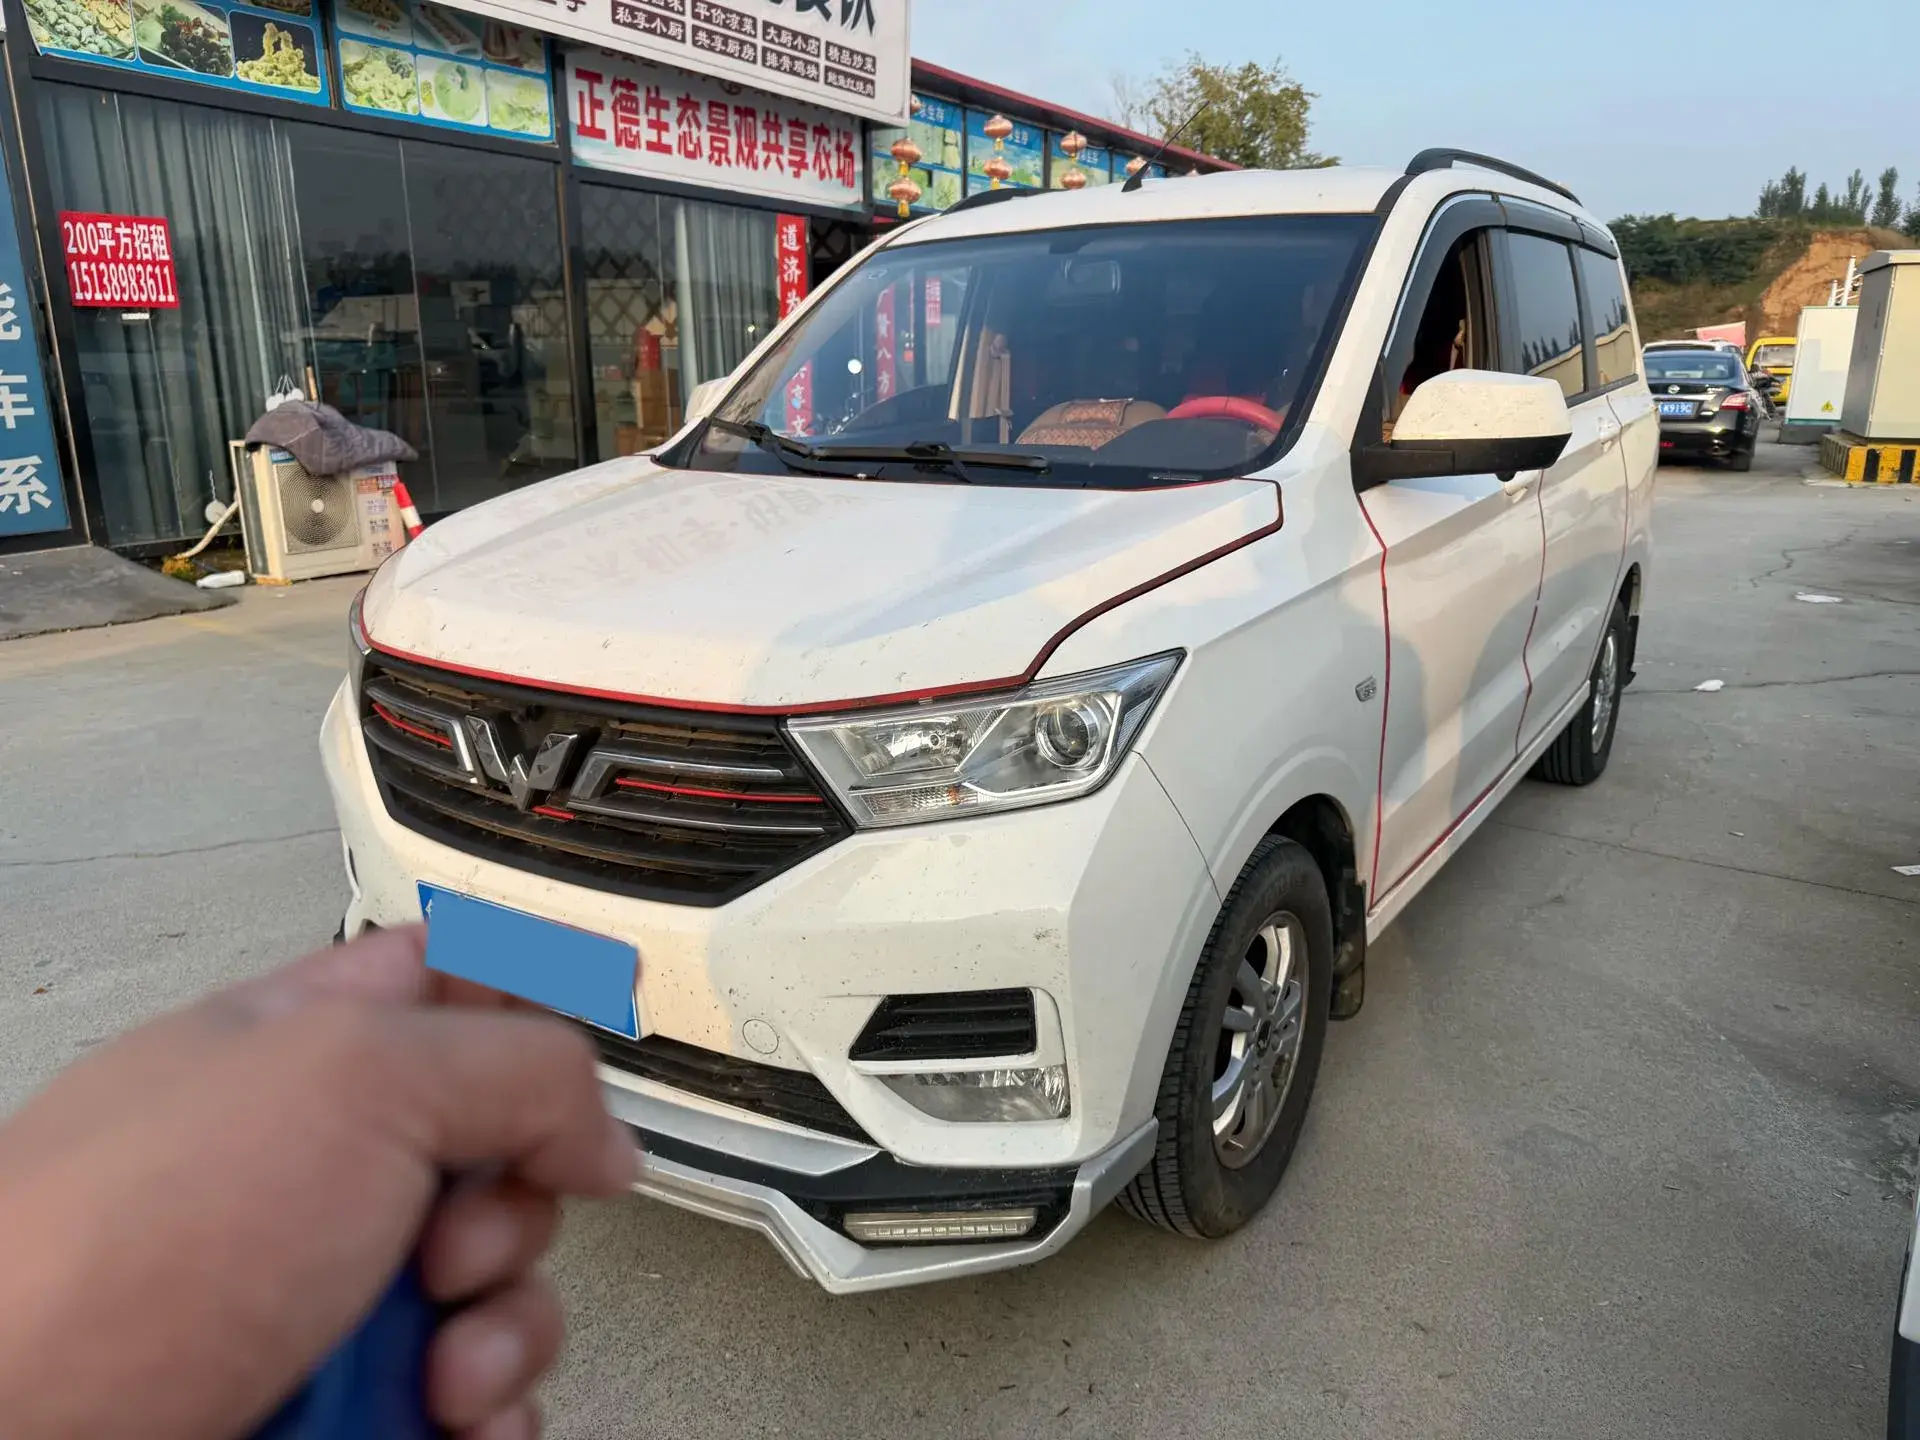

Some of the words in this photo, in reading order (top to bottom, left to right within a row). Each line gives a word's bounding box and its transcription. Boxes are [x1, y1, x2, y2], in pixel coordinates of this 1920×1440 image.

[615, 6, 683, 40] 私享小厨
[765, 26, 819, 56] 大厨小店
[694, 30, 755, 61] 共享厨房
[575, 67, 855, 188] 正德生态景观共享农场
[63, 221, 170, 261] 200平方招租
[71, 261, 175, 303] 15138983611
